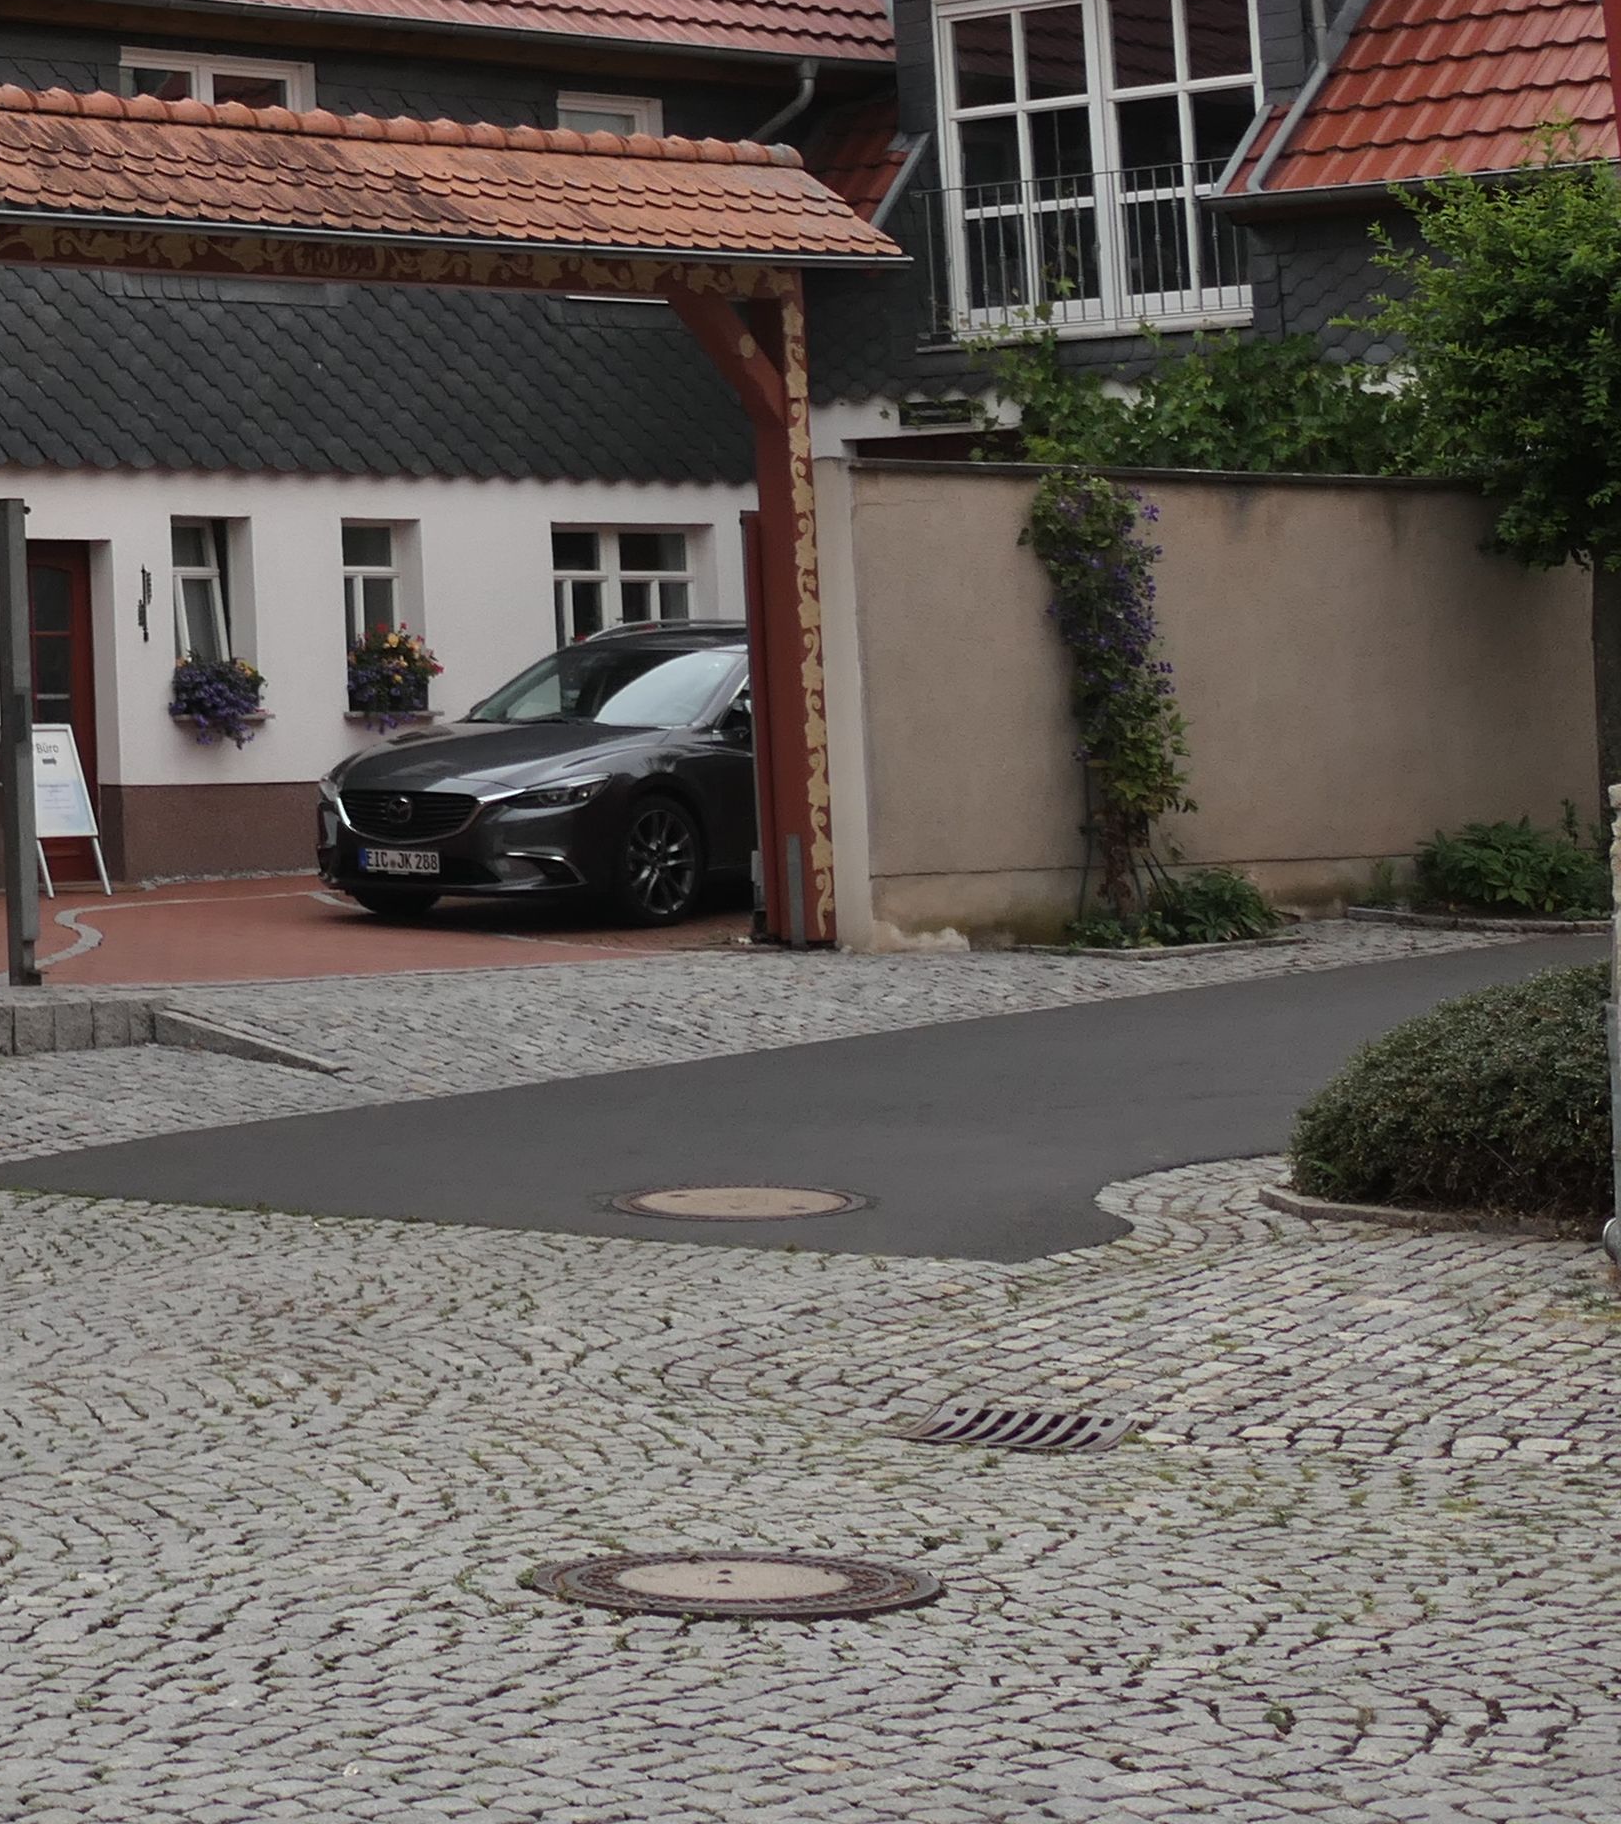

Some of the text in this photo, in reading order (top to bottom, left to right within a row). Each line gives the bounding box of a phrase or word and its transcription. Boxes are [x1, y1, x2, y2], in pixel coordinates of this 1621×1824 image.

[35, 742, 59, 754] Büro
[366, 850, 388, 868] EIC
[415, 853, 438, 871] 288
